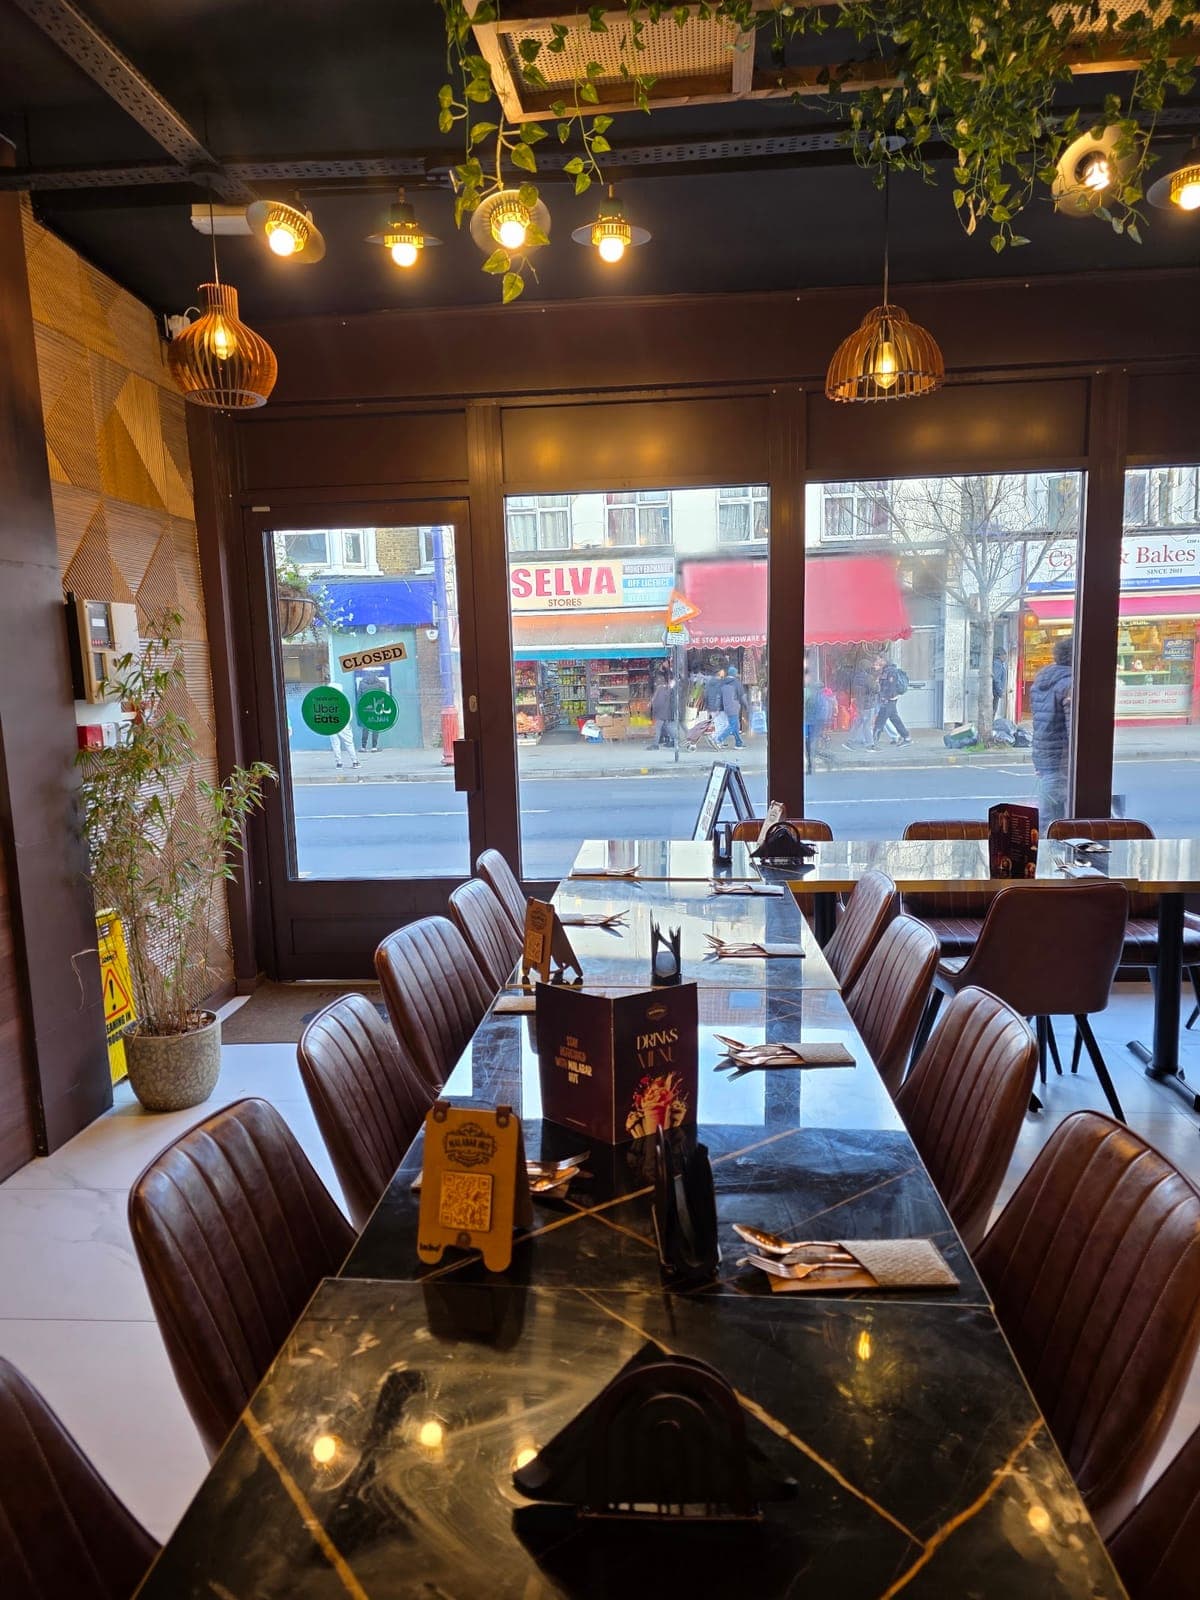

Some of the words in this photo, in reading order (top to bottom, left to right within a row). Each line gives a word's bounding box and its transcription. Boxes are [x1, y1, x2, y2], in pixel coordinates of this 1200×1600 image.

[1136, 544, 1196, 564] Bakes
[511, 567, 616, 598] SELVA
[627, 578, 642, 588] OFF
[547, 598, 583, 608] STORES
[702, 636, 718, 644] STOP
[720, 635, 760, 644] HARDWARE
[342, 647, 402, 670] CLOSED
[313, 703, 339, 714] Uber
[314, 714, 340, 724] Eats
[636, 1027, 679, 1052] DRINKS
